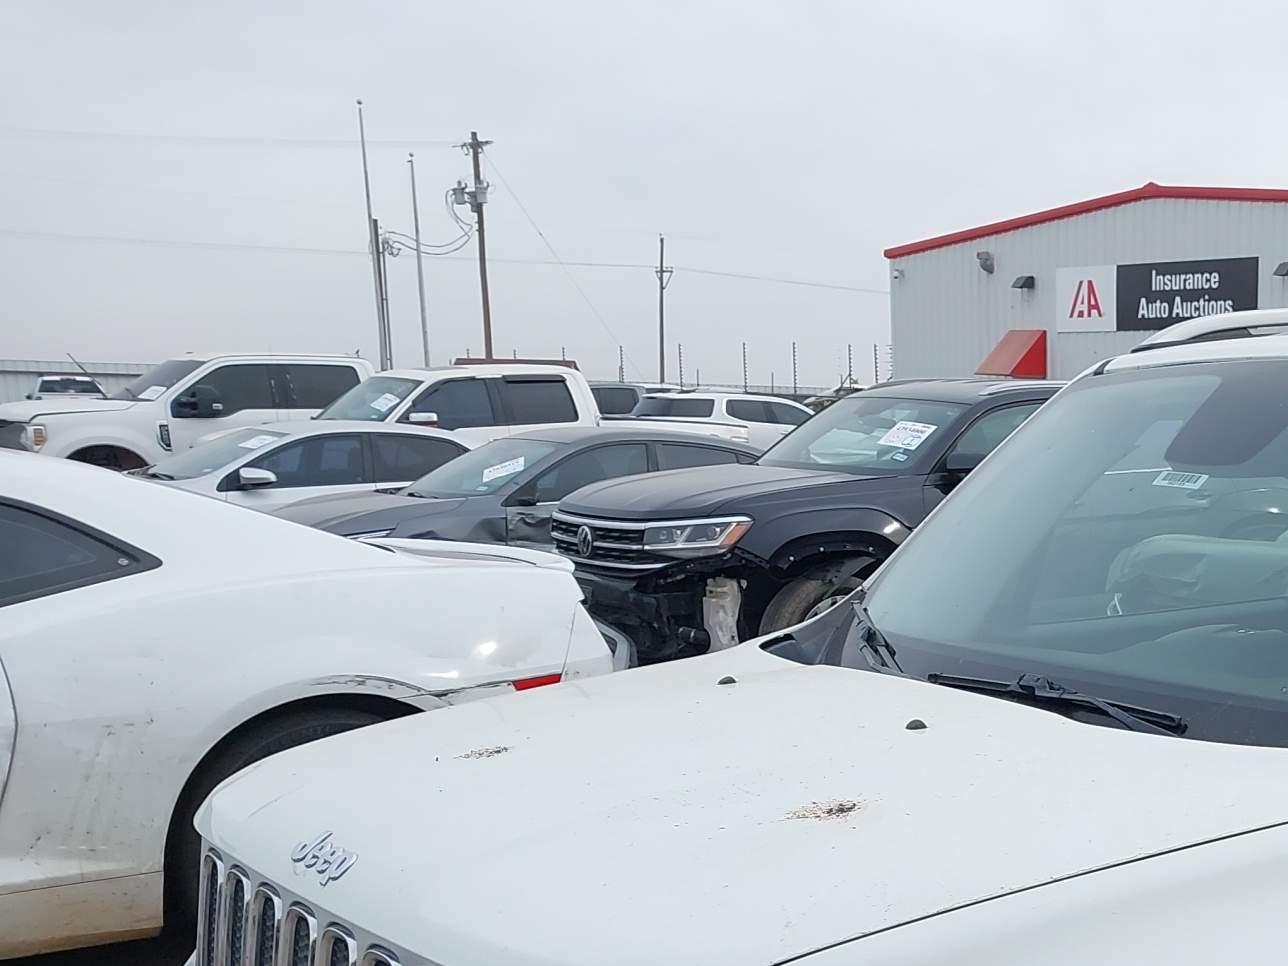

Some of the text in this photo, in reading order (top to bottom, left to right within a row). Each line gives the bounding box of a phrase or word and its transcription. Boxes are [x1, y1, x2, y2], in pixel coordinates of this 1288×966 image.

[1152, 270, 1220, 291] Insurance
[1138, 295, 1234, 319] Auto Auctions
[291, 831, 359, 888] Jeep
